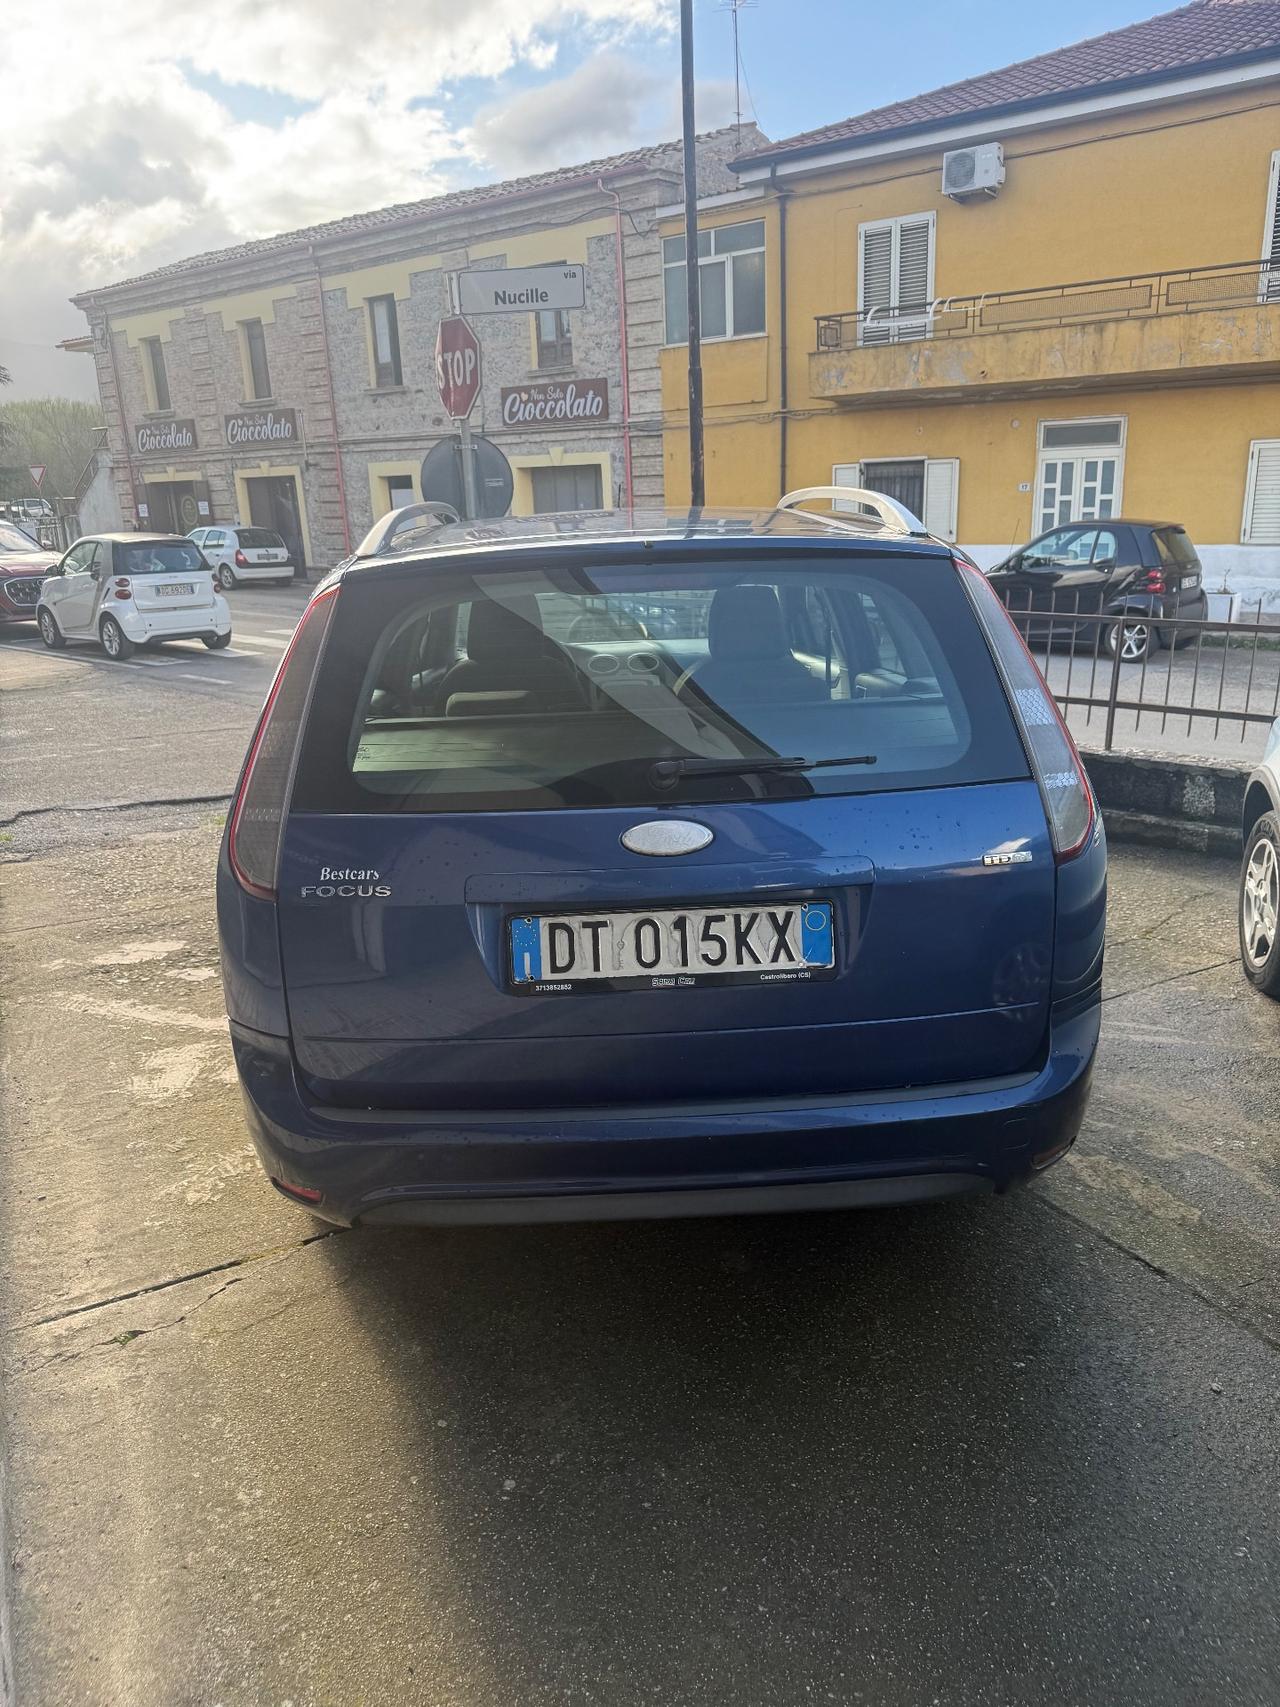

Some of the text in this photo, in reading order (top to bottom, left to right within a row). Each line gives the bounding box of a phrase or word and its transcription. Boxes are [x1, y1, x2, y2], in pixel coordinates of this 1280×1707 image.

[563, 270, 577, 279] via
[494, 288, 549, 305] Nucille
[437, 348, 476, 390] STOP
[503, 384, 603, 424] Cioccolato
[138, 423, 193, 452] Cioccolato
[227, 412, 292, 444] Cioccolato
[320, 867, 380, 881] Bestcars
[301, 885, 392, 898] FOCUS
[548, 911, 797, 974] DT 015KX
